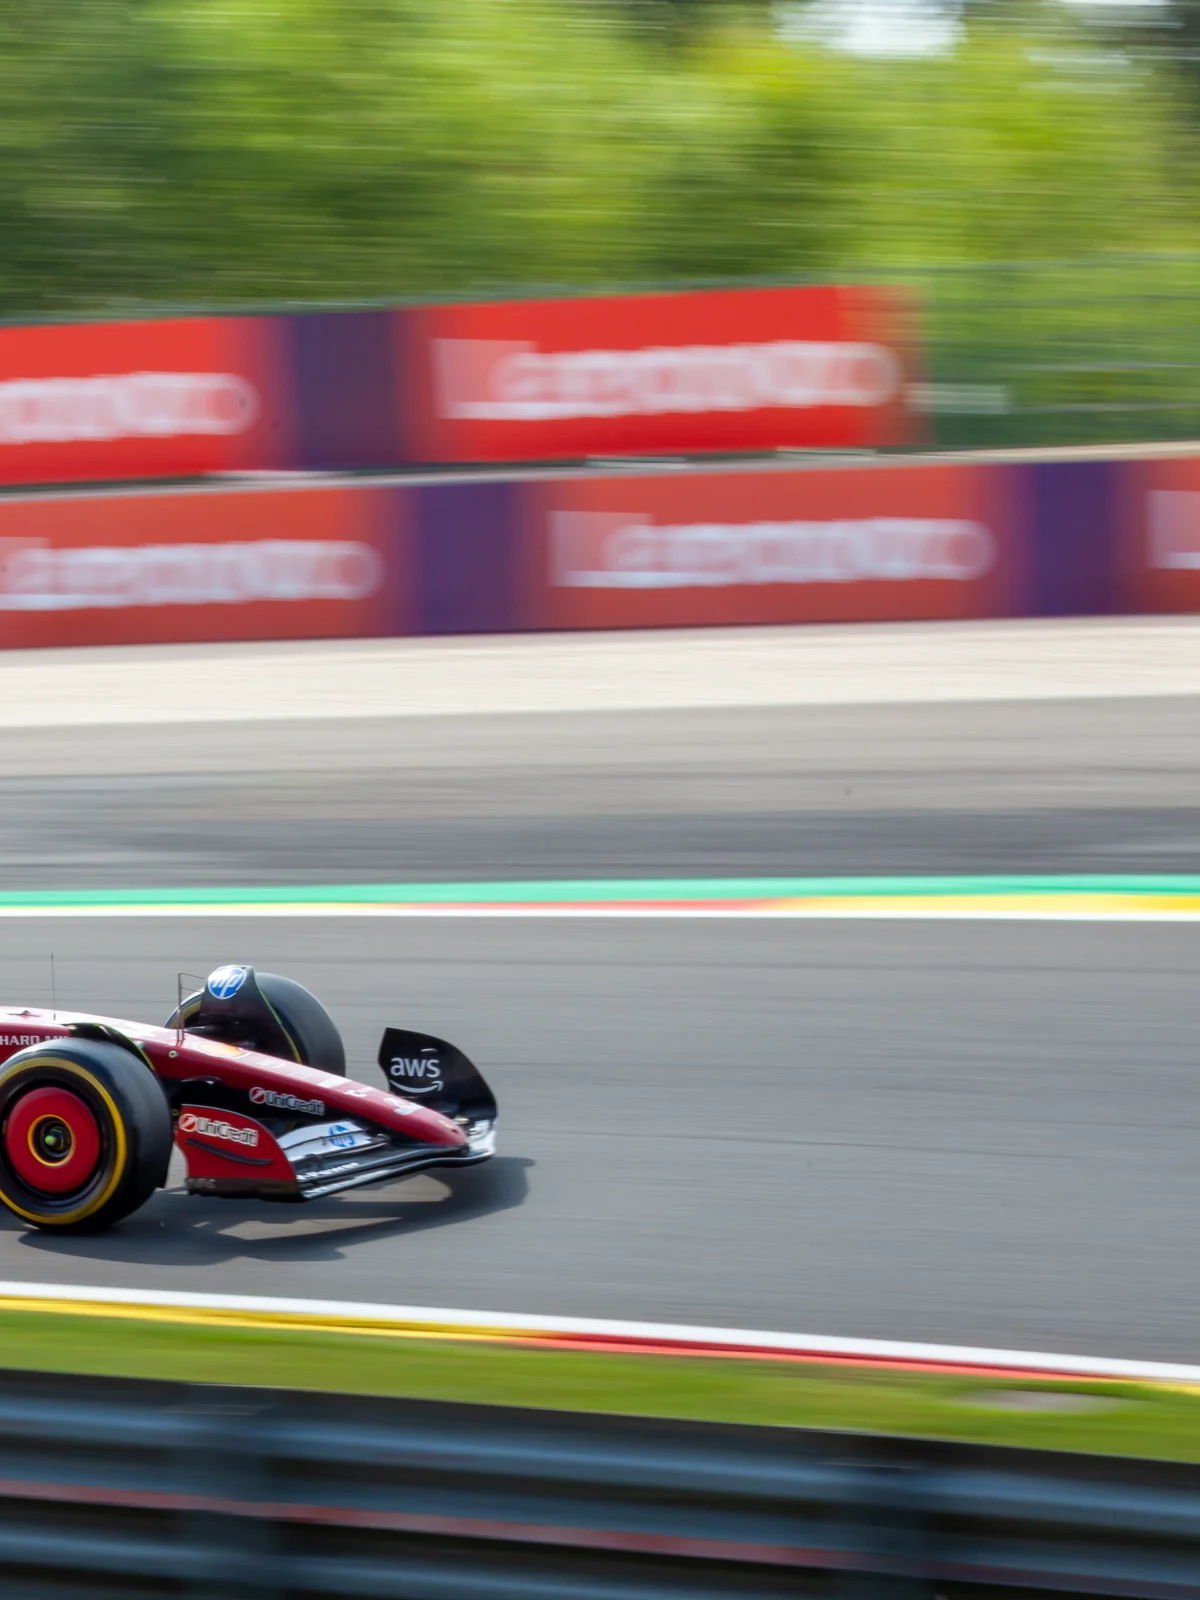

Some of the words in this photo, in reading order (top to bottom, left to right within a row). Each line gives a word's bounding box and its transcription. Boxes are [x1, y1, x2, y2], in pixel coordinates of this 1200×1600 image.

[390, 1057, 441, 1078] aws
[264, 1090, 326, 1117] UniCredit
[196, 1116, 259, 1147] UniCredit
